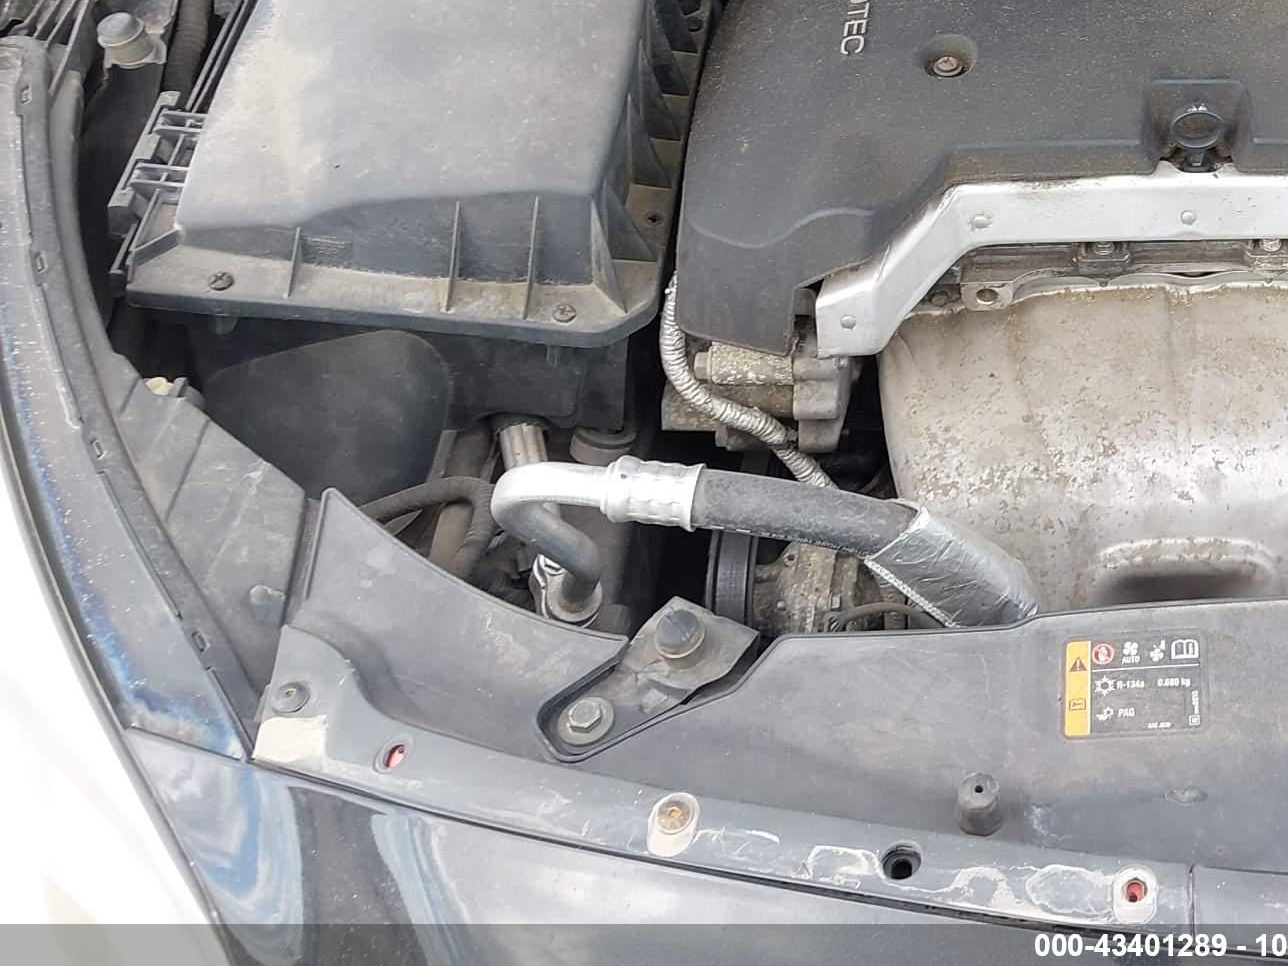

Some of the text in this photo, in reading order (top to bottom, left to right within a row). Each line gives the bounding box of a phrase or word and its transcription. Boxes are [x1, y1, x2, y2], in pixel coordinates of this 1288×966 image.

[1122, 655, 1140, 665] AUTO
[1180, 677, 1191, 688] kg
[1118, 708, 1135, 717] PAG
